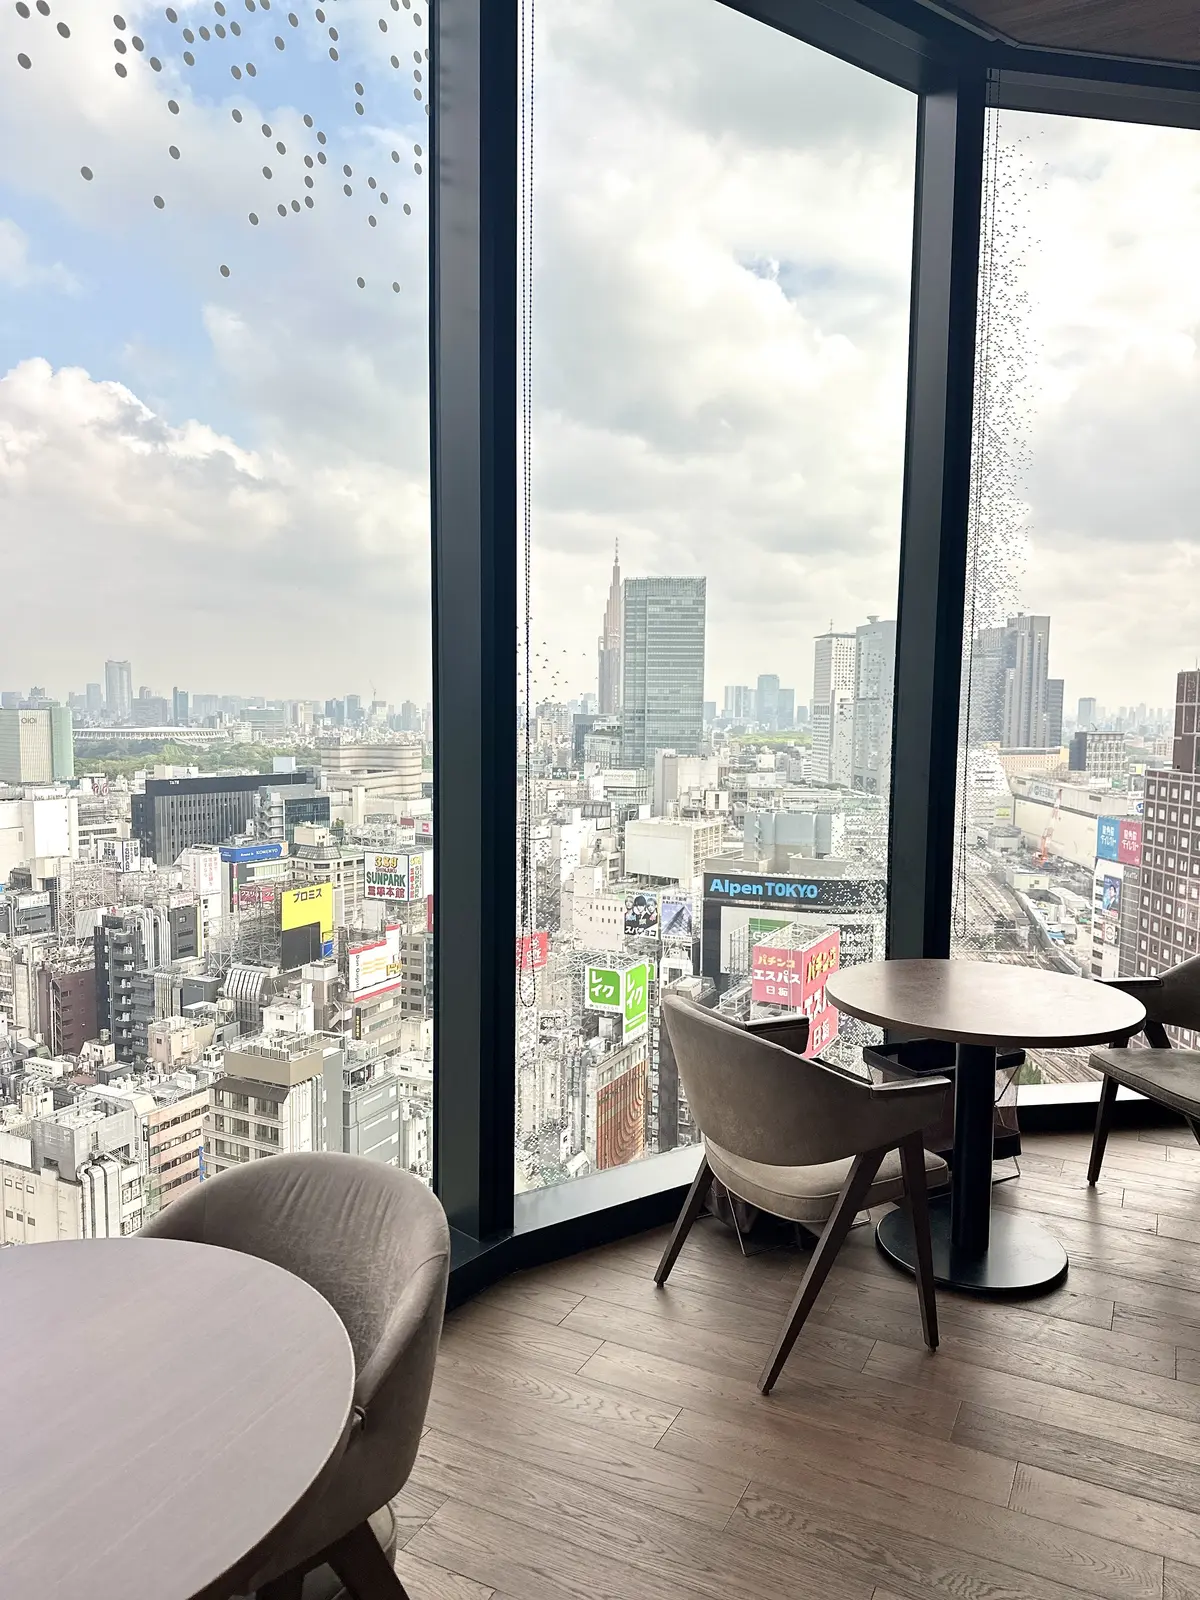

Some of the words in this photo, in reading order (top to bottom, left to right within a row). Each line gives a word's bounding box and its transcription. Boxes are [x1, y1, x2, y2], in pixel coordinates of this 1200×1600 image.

[366, 871, 406, 887] SUNPARK
[293, 888, 322, 903] プロミス
[709, 878, 763, 897] Alpen
[764, 881, 818, 899] TOKYO
[758, 954, 796, 968] パチンコ
[806, 946, 837, 984] パチンコ
[753, 969, 801, 985] エスパス
